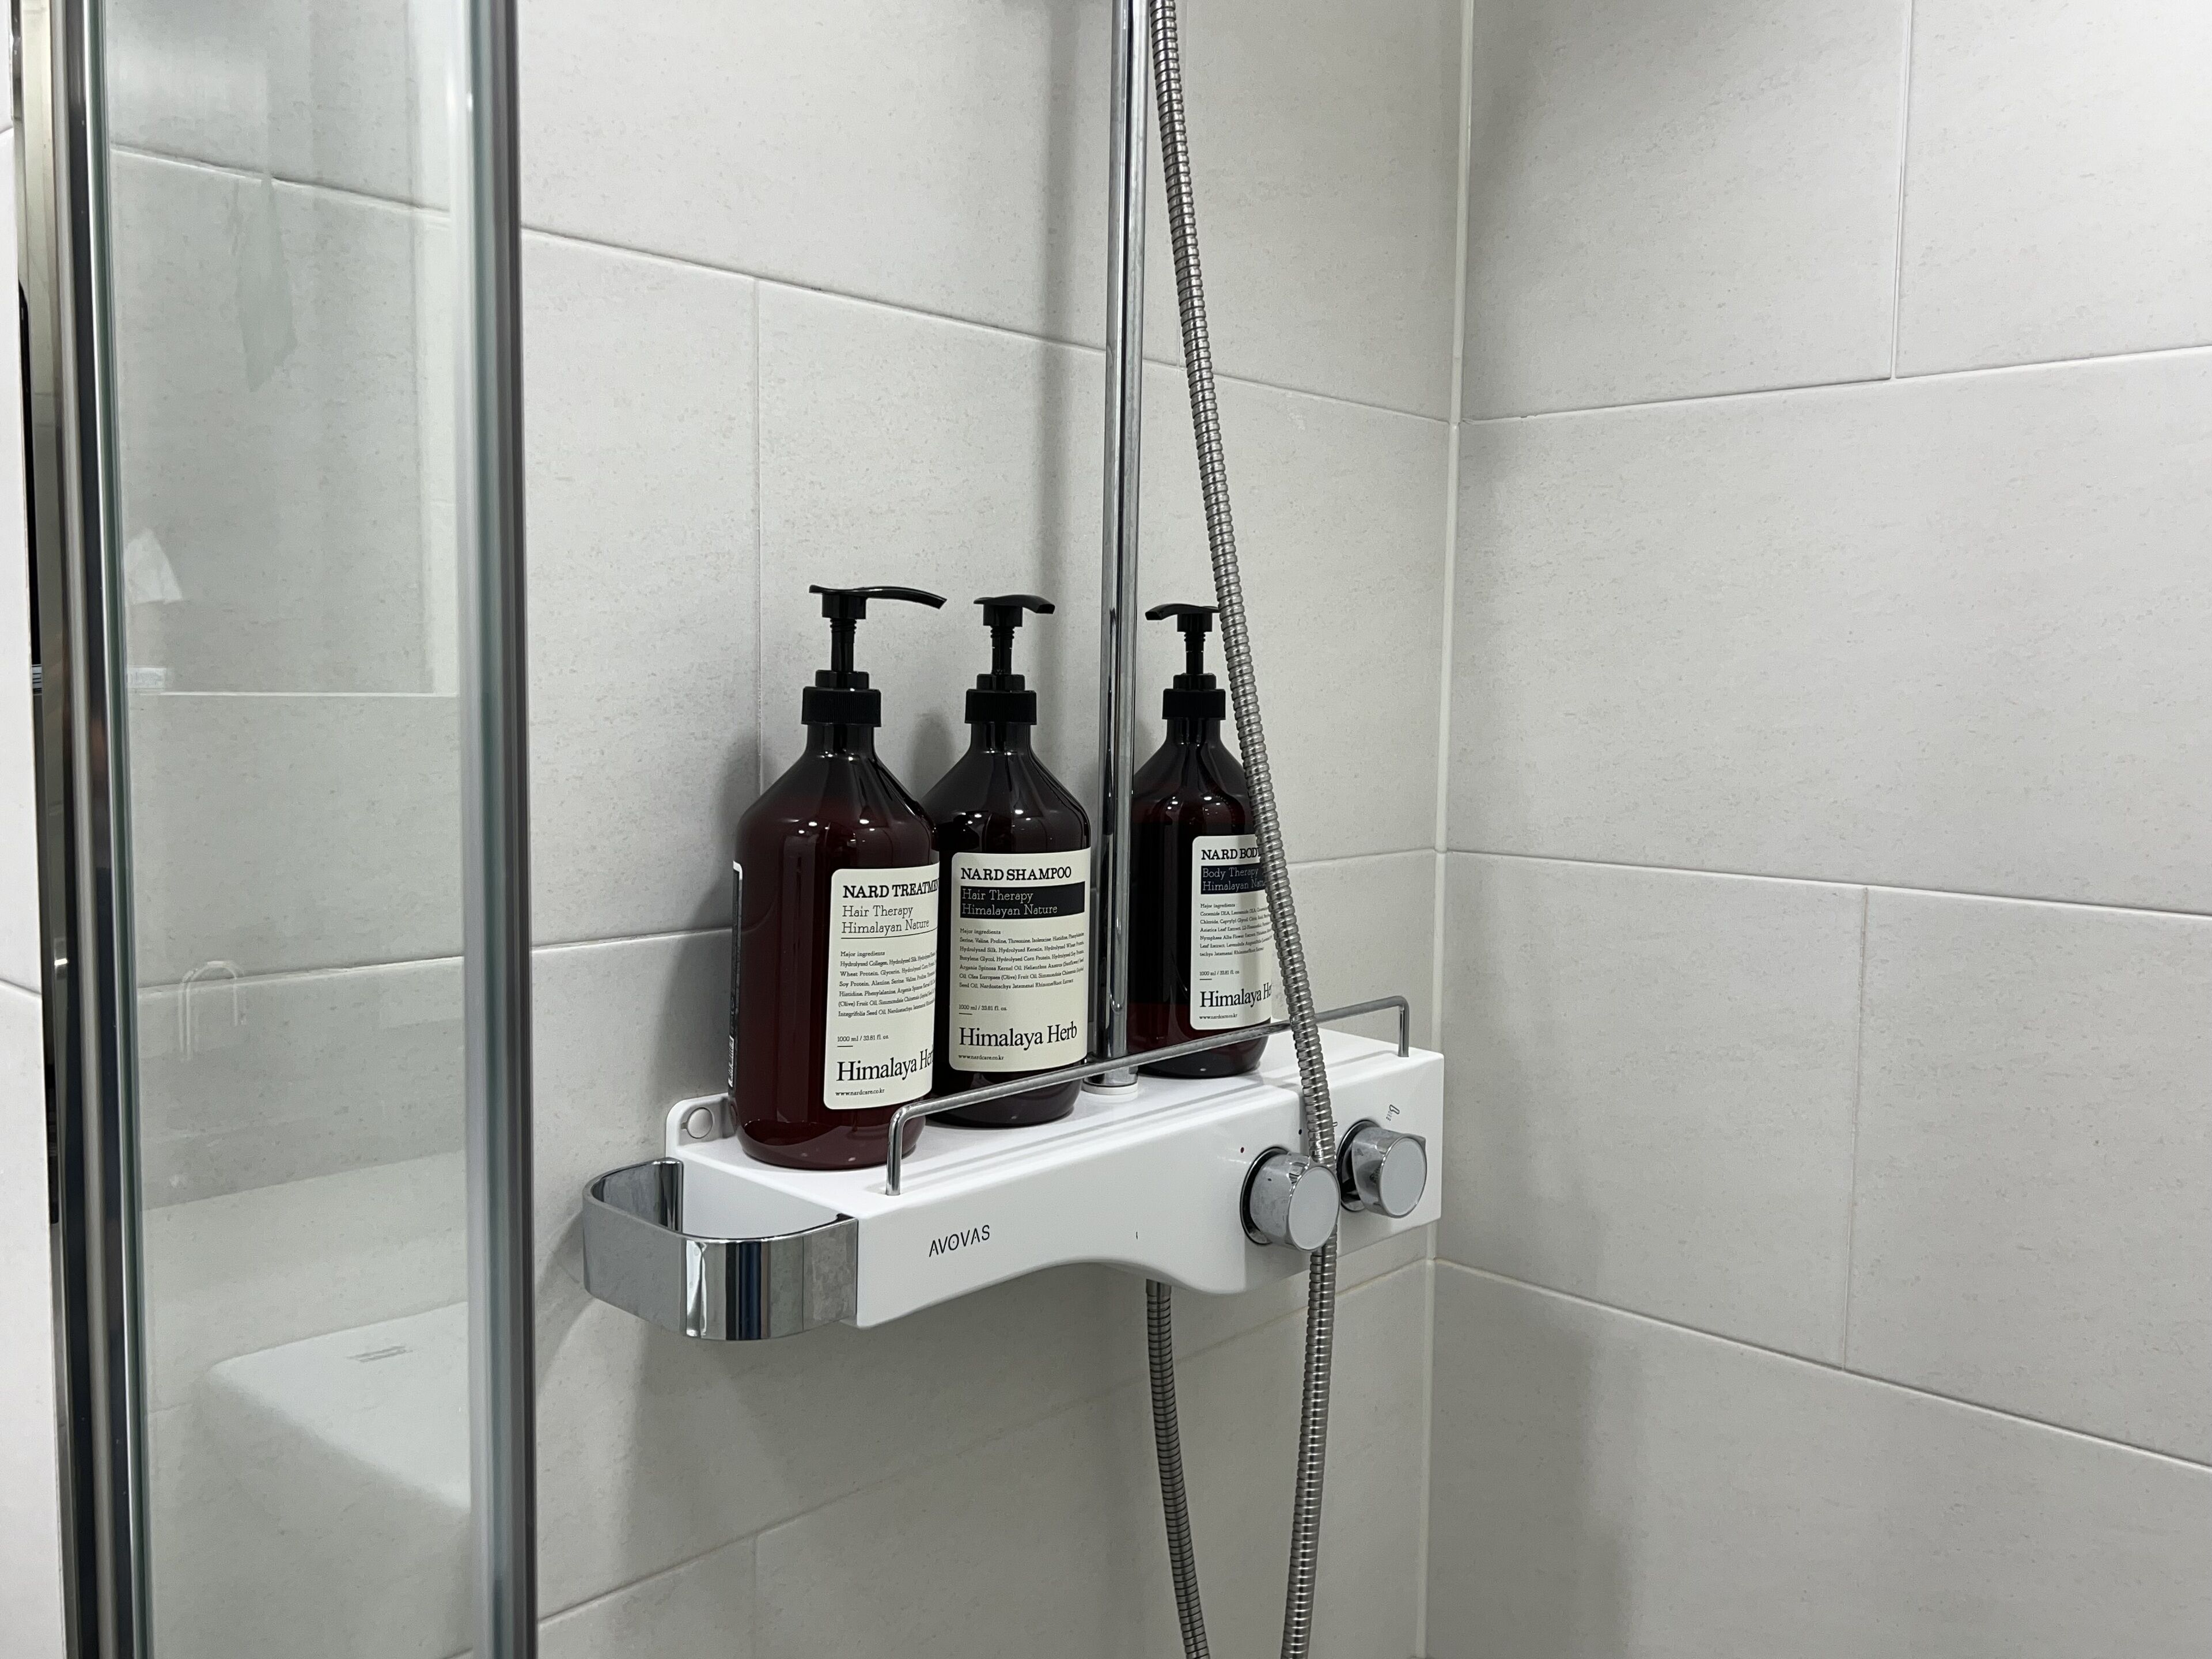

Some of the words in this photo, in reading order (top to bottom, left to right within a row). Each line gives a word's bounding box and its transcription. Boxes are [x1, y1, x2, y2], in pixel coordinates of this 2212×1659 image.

[1201, 849, 1238, 860] NARD
[960, 868, 1004, 881] NARD
[1006, 866, 1071, 881] SHAMPOO
[1202, 868, 1226, 880] Body
[1228, 867, 1259, 878] Therapy
[842, 885, 889, 898] NARD
[1202, 880, 1249, 892] Himalayan
[961, 888, 986, 900] Hair
[988, 889, 1034, 904] Therapy
[842, 906, 869, 917] Hair
[873, 905, 914, 919] Therapy
[961, 903, 1021, 918] Himalayan
[1023, 903, 1058, 915] Nature
[841, 922, 902, 936] Himalayan
[905, 919, 930, 931] Nature
[1199, 988, 1262, 1007] Himalaya
[959, 1027, 1044, 1051] Himalaya
[1047, 1020, 1077, 1044] Herb
[836, 1056, 918, 1081] Himalaya
[929, 1225, 990, 1257] AVOVAS
